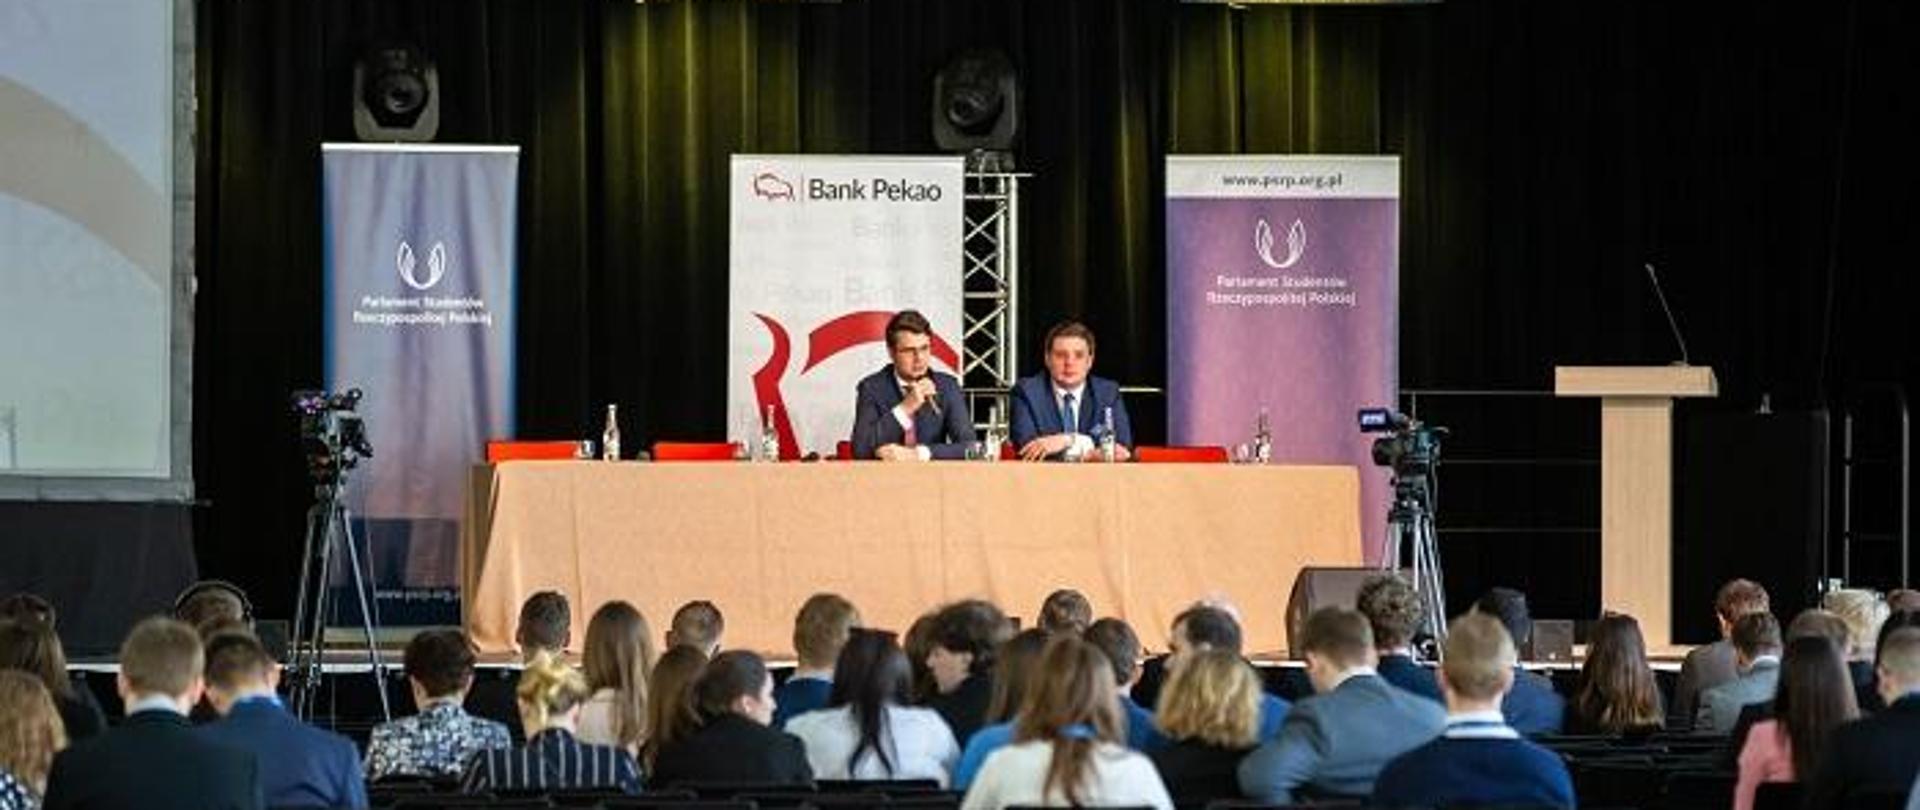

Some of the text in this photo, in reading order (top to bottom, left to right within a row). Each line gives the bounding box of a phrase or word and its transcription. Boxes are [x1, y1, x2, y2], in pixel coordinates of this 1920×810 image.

[1222, 174, 1343, 188] www.psrp.org.pl
[808, 178, 942, 201] Bank Pekao
[1308, 292, 1356, 306] Polskiej
